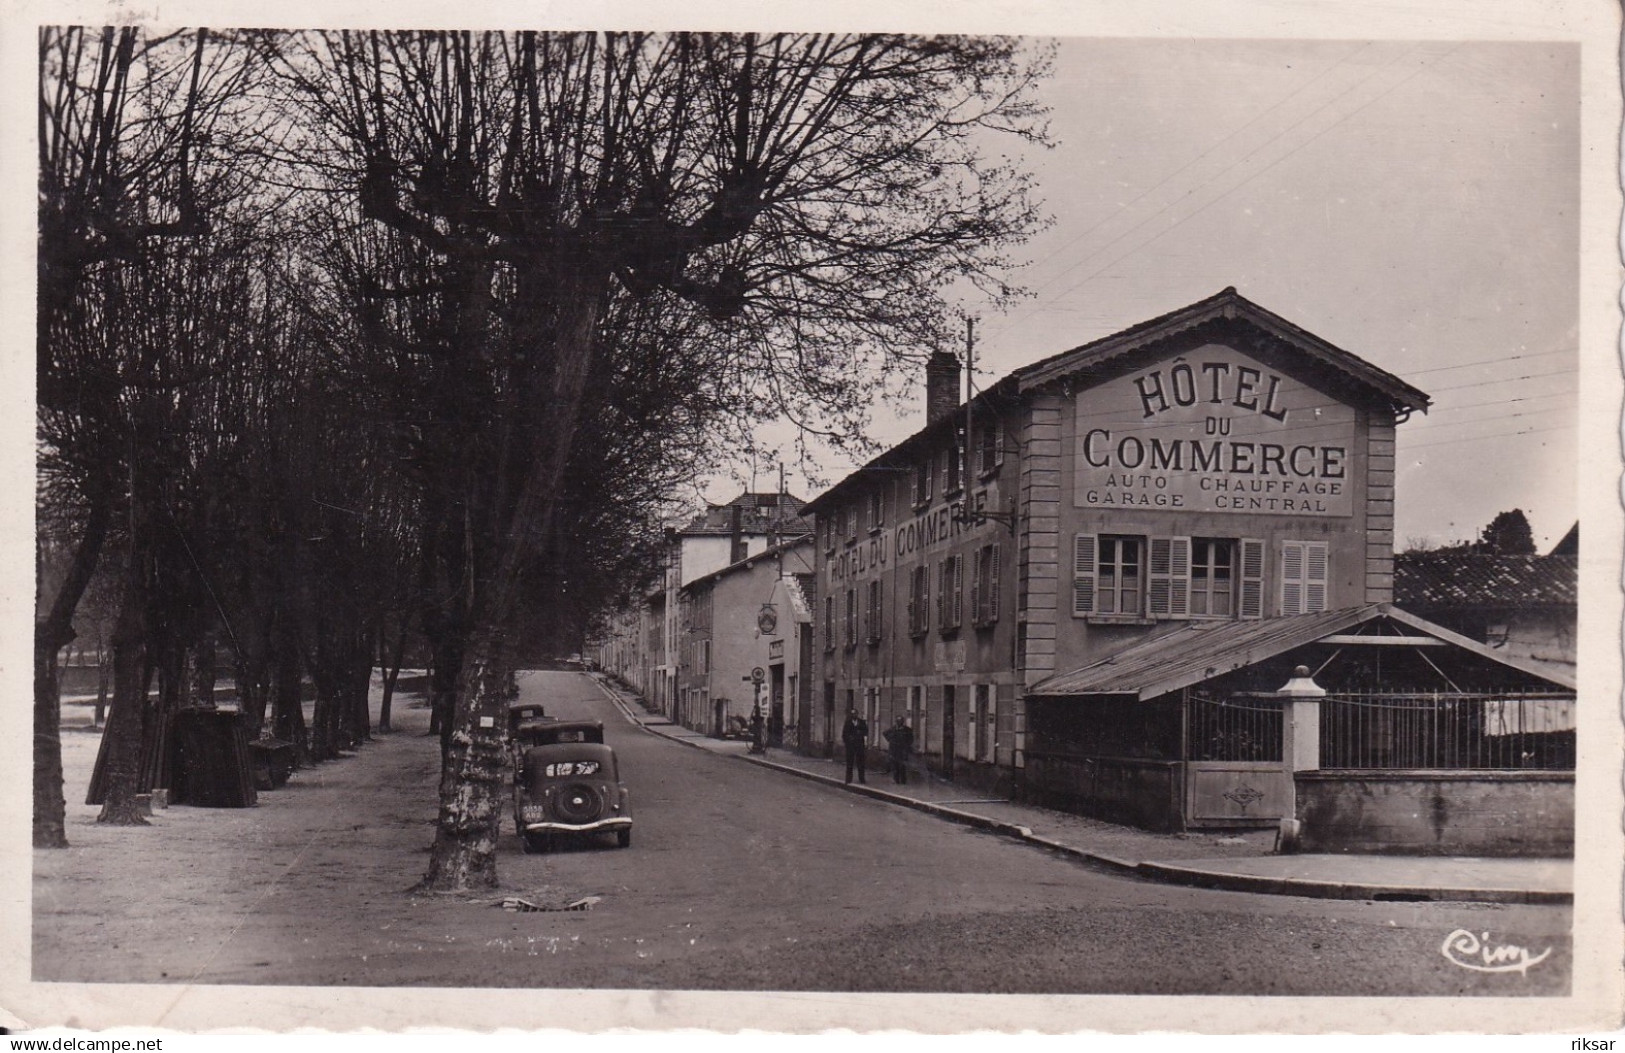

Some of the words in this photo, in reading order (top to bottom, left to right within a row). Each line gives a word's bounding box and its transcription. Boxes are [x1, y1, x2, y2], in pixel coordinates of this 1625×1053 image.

[1133, 357, 1288, 423] HÔTEL
[1206, 416, 1230, 436] DU
[1083, 429, 1346, 479] COMMERCE
[1105, 473, 1168, 489] AUTO
[1199, 477, 1342, 496] CHAUFFAGE
[1086, 490, 1184, 508] GARAGE
[1214, 495, 1327, 512] CENTRAL
[870, 535, 888, 569] DU
